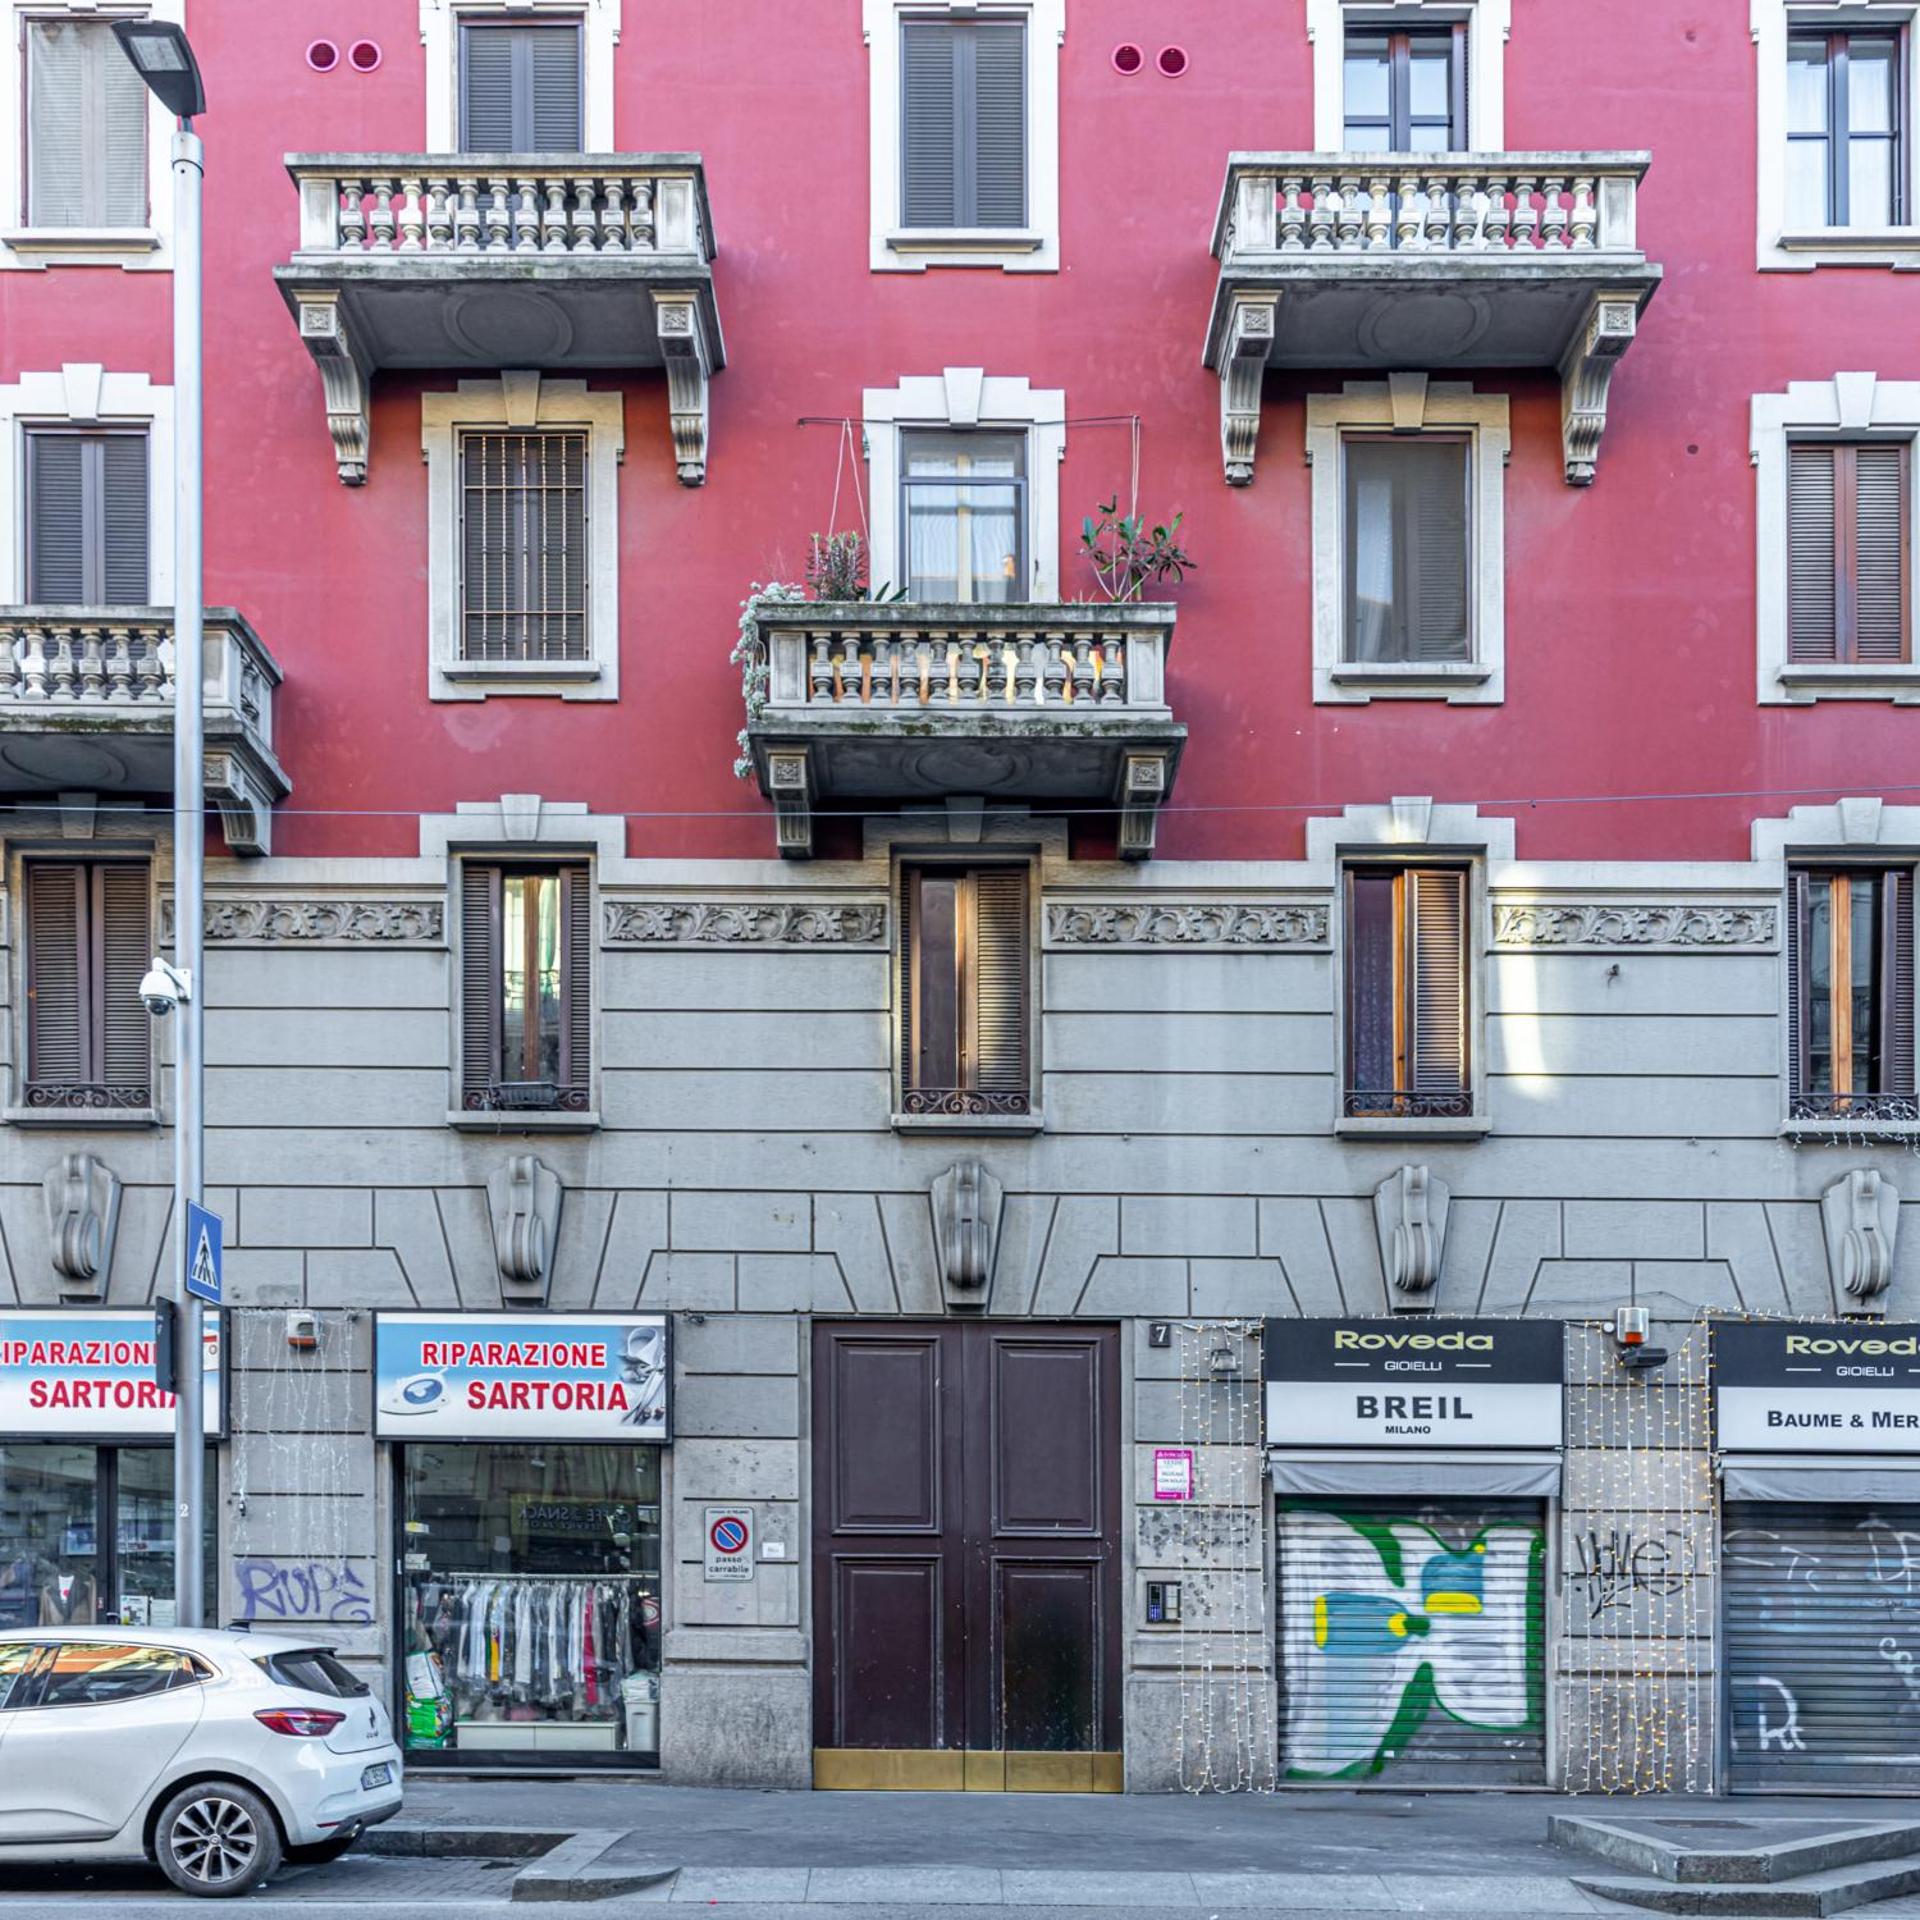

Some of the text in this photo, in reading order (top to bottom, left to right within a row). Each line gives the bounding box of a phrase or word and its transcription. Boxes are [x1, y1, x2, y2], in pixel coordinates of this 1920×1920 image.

[1155, 1325, 1167, 1343] 7
[1334, 1331, 1494, 1350] Roveda
[0, 1341, 157, 1365] IPARAZION
[1785, 1335, 1920, 1355] Roved
[422, 1342, 606, 1367] RIPARAZIONE
[1384, 1360, 1443, 1372] GIOIELLI
[1836, 1366, 1895, 1377] GIOIELLI
[467, 1381, 629, 1411] SARTORIA
[1356, 1396, 1473, 1419] BREIL
[1849, 1413, 1864, 1428] &
[1385, 1425, 1431, 1435] MILANO
[179, 1503, 189, 1518] 2
[708, 1565, 749, 1573] carrabile
